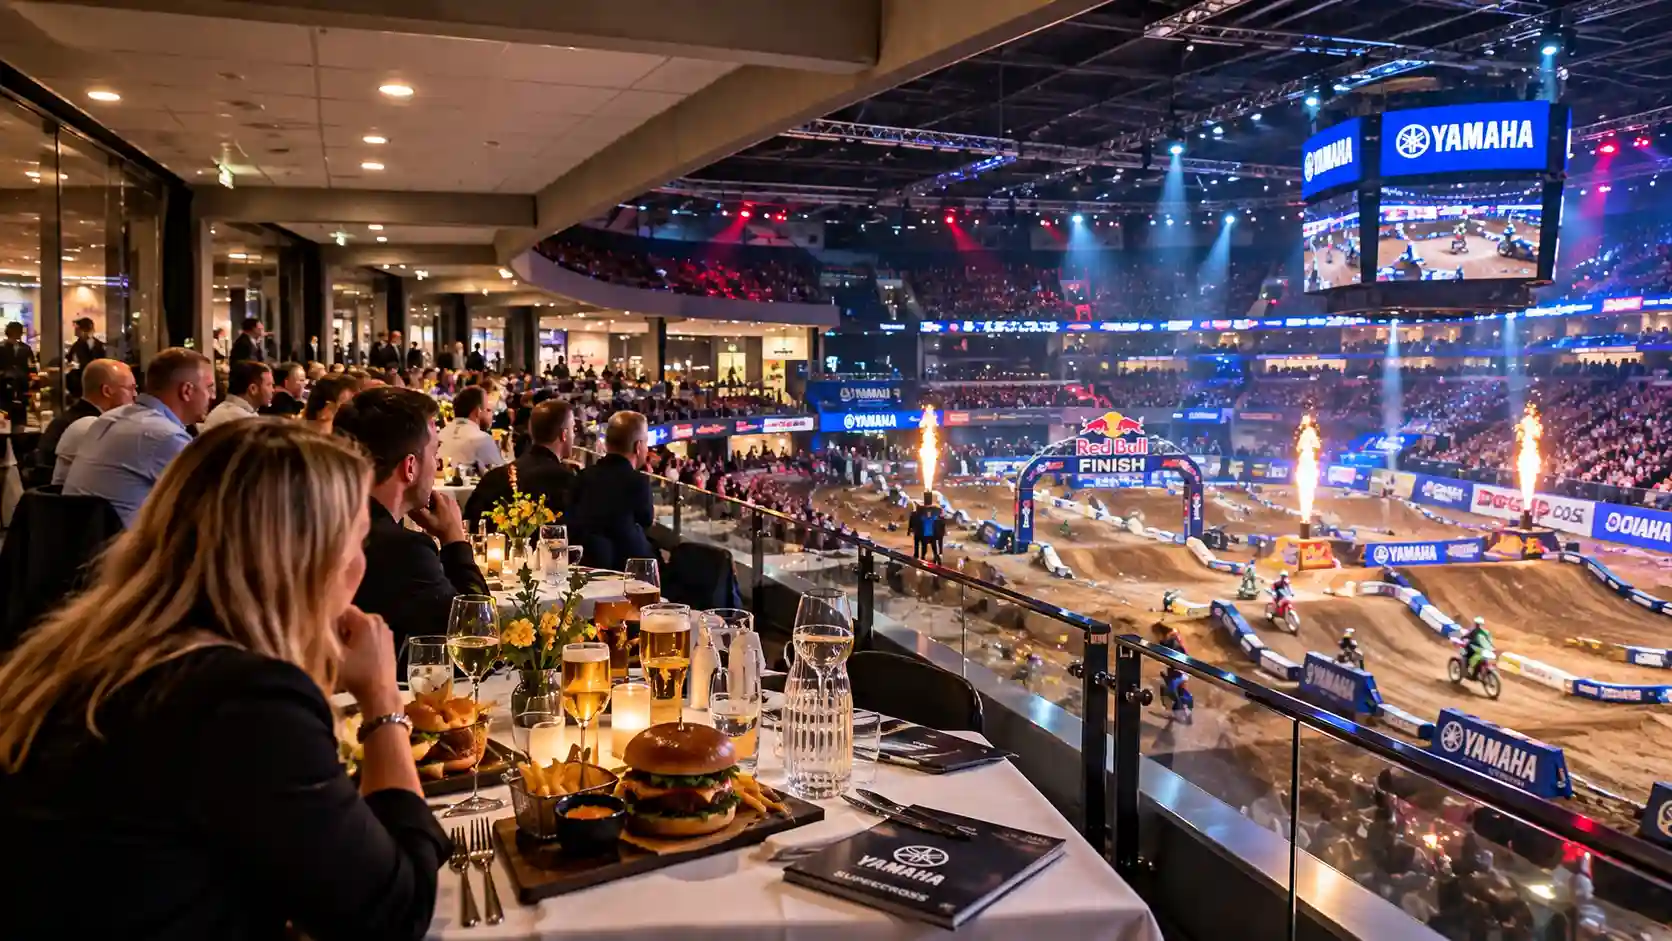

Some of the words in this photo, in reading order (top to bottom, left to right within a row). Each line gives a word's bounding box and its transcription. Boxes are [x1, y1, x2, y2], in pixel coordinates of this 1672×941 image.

[1431, 119, 1534, 153] YAMAHA
[1076, 438, 1112, 456] Red
[1113, 437, 1148, 455] Bull
[1079, 457, 1145, 473] FINISH
[1388, 544, 1437, 562] YAMAHA
[1464, 728, 1537, 783] YAMAHA
[857, 855, 945, 886] YAMAHA
